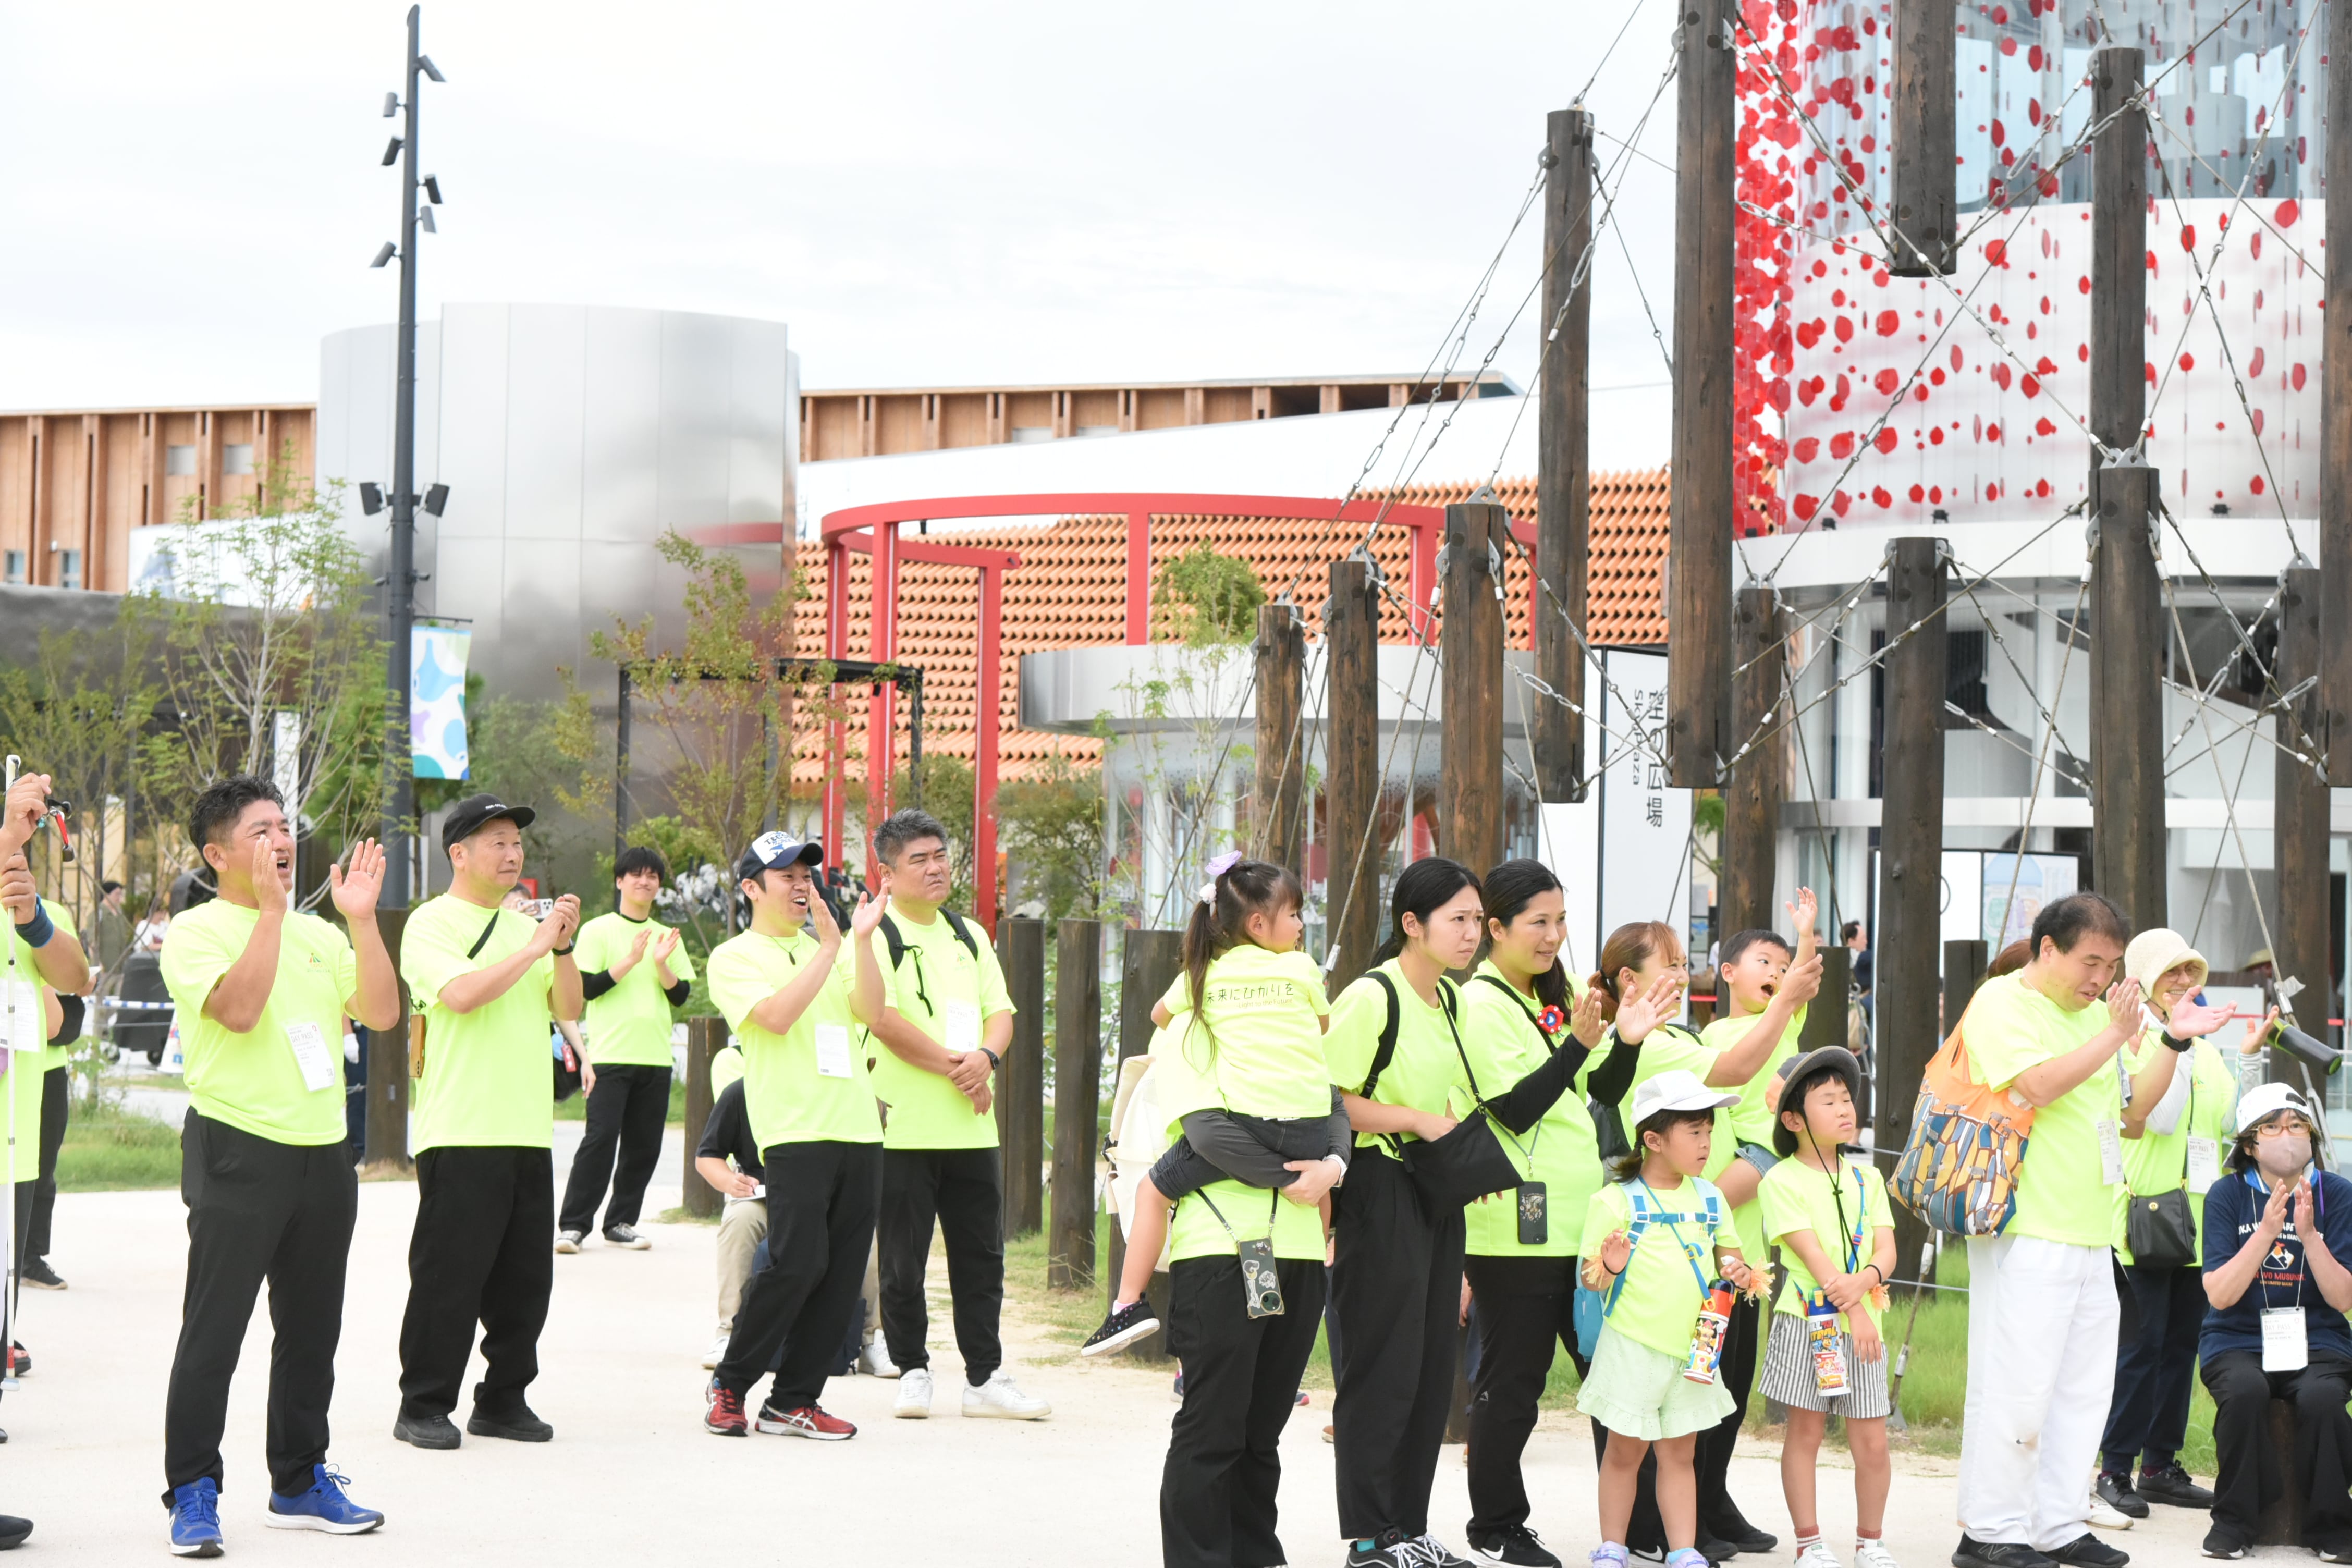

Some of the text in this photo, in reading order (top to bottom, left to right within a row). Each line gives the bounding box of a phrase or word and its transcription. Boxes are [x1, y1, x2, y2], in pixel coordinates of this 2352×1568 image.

[1207, 983, 1294, 1004] 未来にひかりを
[291, 1032, 313, 1043] DAY PASS
